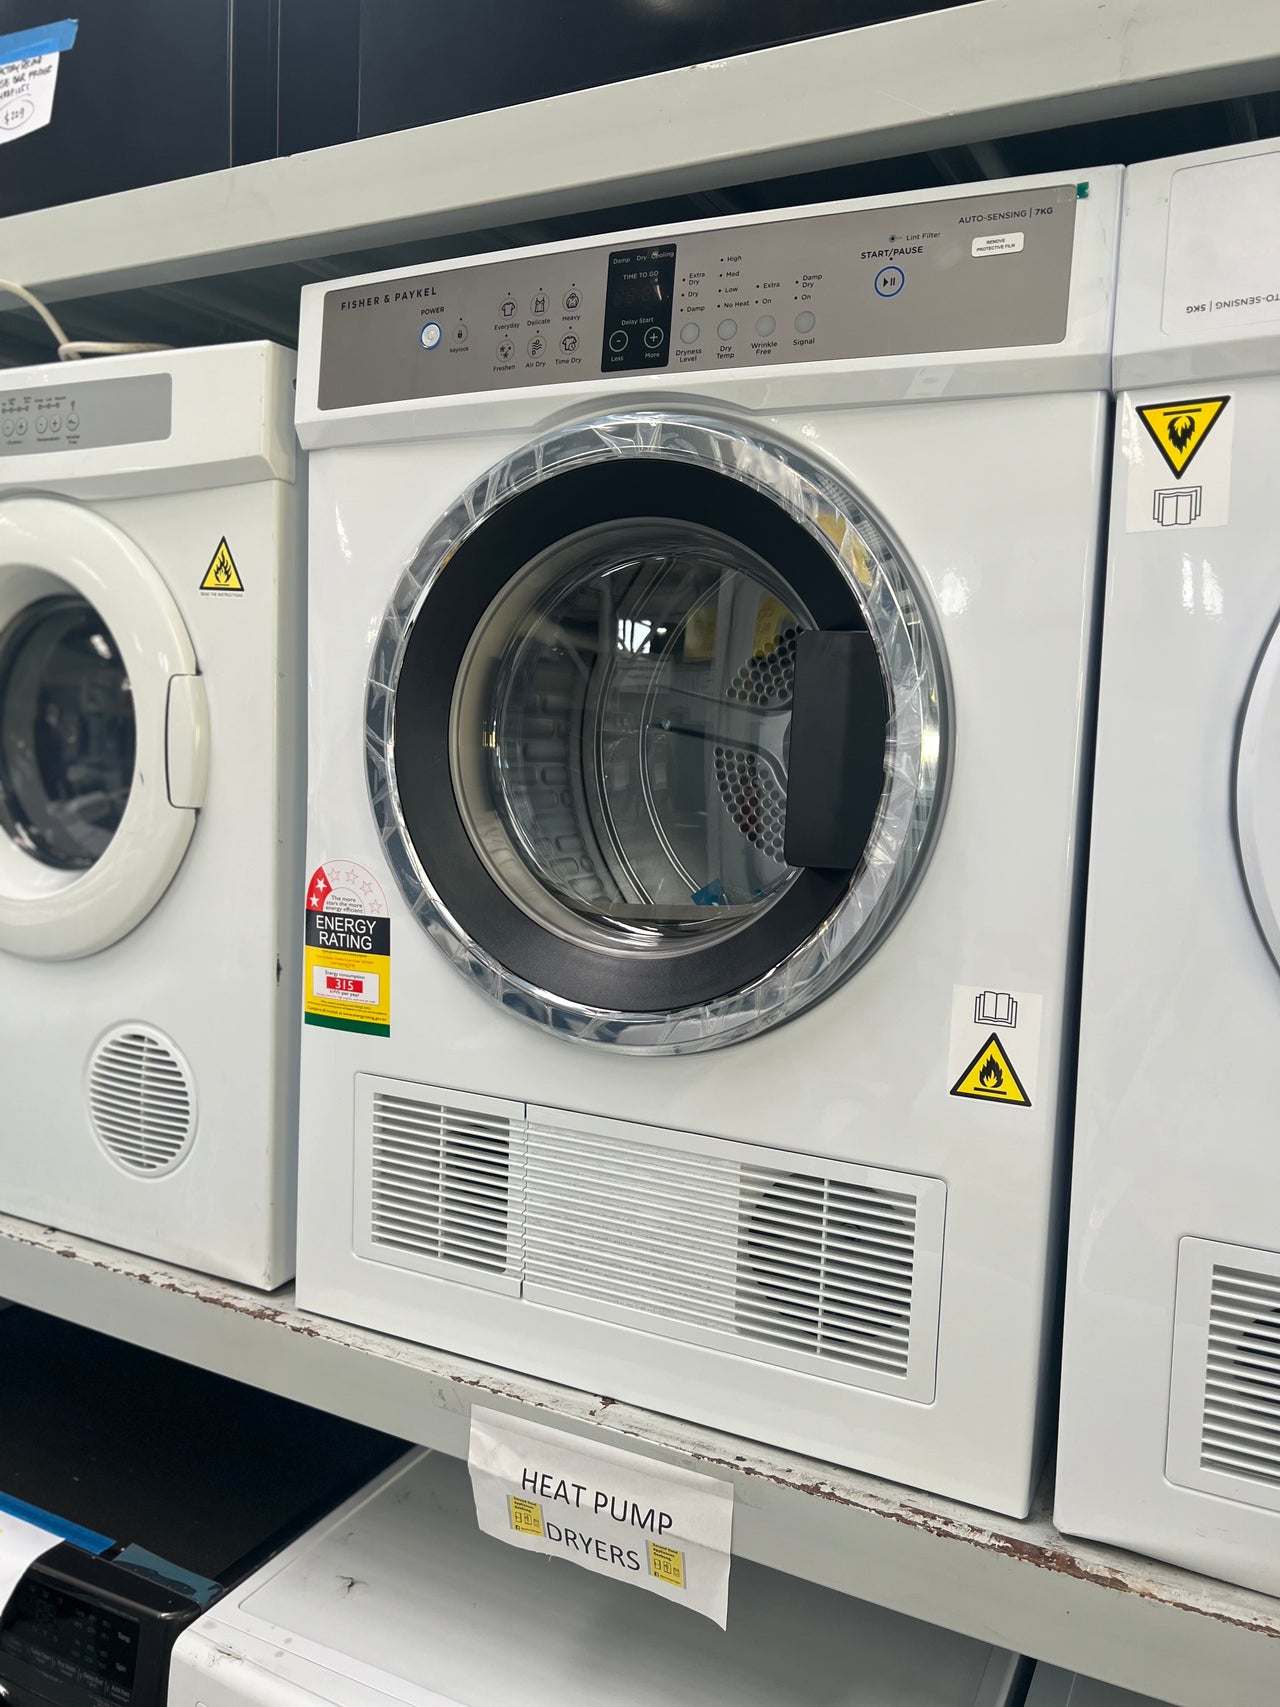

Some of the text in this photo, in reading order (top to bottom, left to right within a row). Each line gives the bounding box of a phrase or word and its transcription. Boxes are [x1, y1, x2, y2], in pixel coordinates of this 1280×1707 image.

[959, 209, 1027, 224] AUTO-SENSING
[1035, 207, 1053, 216] 7KG
[906, 231, 941, 242] Lint Filter
[860, 245, 924, 260] START/PAUSE
[613, 257, 631, 265] Damp
[651, 251, 675, 259] Cooling
[727, 255, 742, 264] High
[726, 270, 740, 278] Med
[802, 273, 823, 282] Damp
[763, 281, 781, 289] Extra
[802, 281, 815, 289] Dry
[341, 287, 437, 311] FISHER & PAYKEL
[686, 305, 706, 313] Damp
[723, 300, 750, 309] No Heat
[1185, 303, 1207, 314] 5KG
[420, 306, 445, 316] POWER
[494, 322, 520, 331] Everyday
[527, 318, 551, 326] Delicate
[751, 340, 778, 349] Wrinkle
[792, 338, 815, 347] Signal
[676, 348, 702, 356] Dryness
[719, 345, 733, 354] Dry
[756, 348, 772, 356] Free
[679, 355, 698, 363] Level
[716, 351, 736, 360] Temp
[570, 357, 582, 365] Dry
[493, 364, 516, 372] Freshen
[316, 914, 376, 935] ENERGY
[319, 931, 372, 950] RATING
[335, 978, 354, 991] 315
[522, 1468, 673, 1535] HEAT PUMP
[546, 1521, 641, 1571] DRYERS
